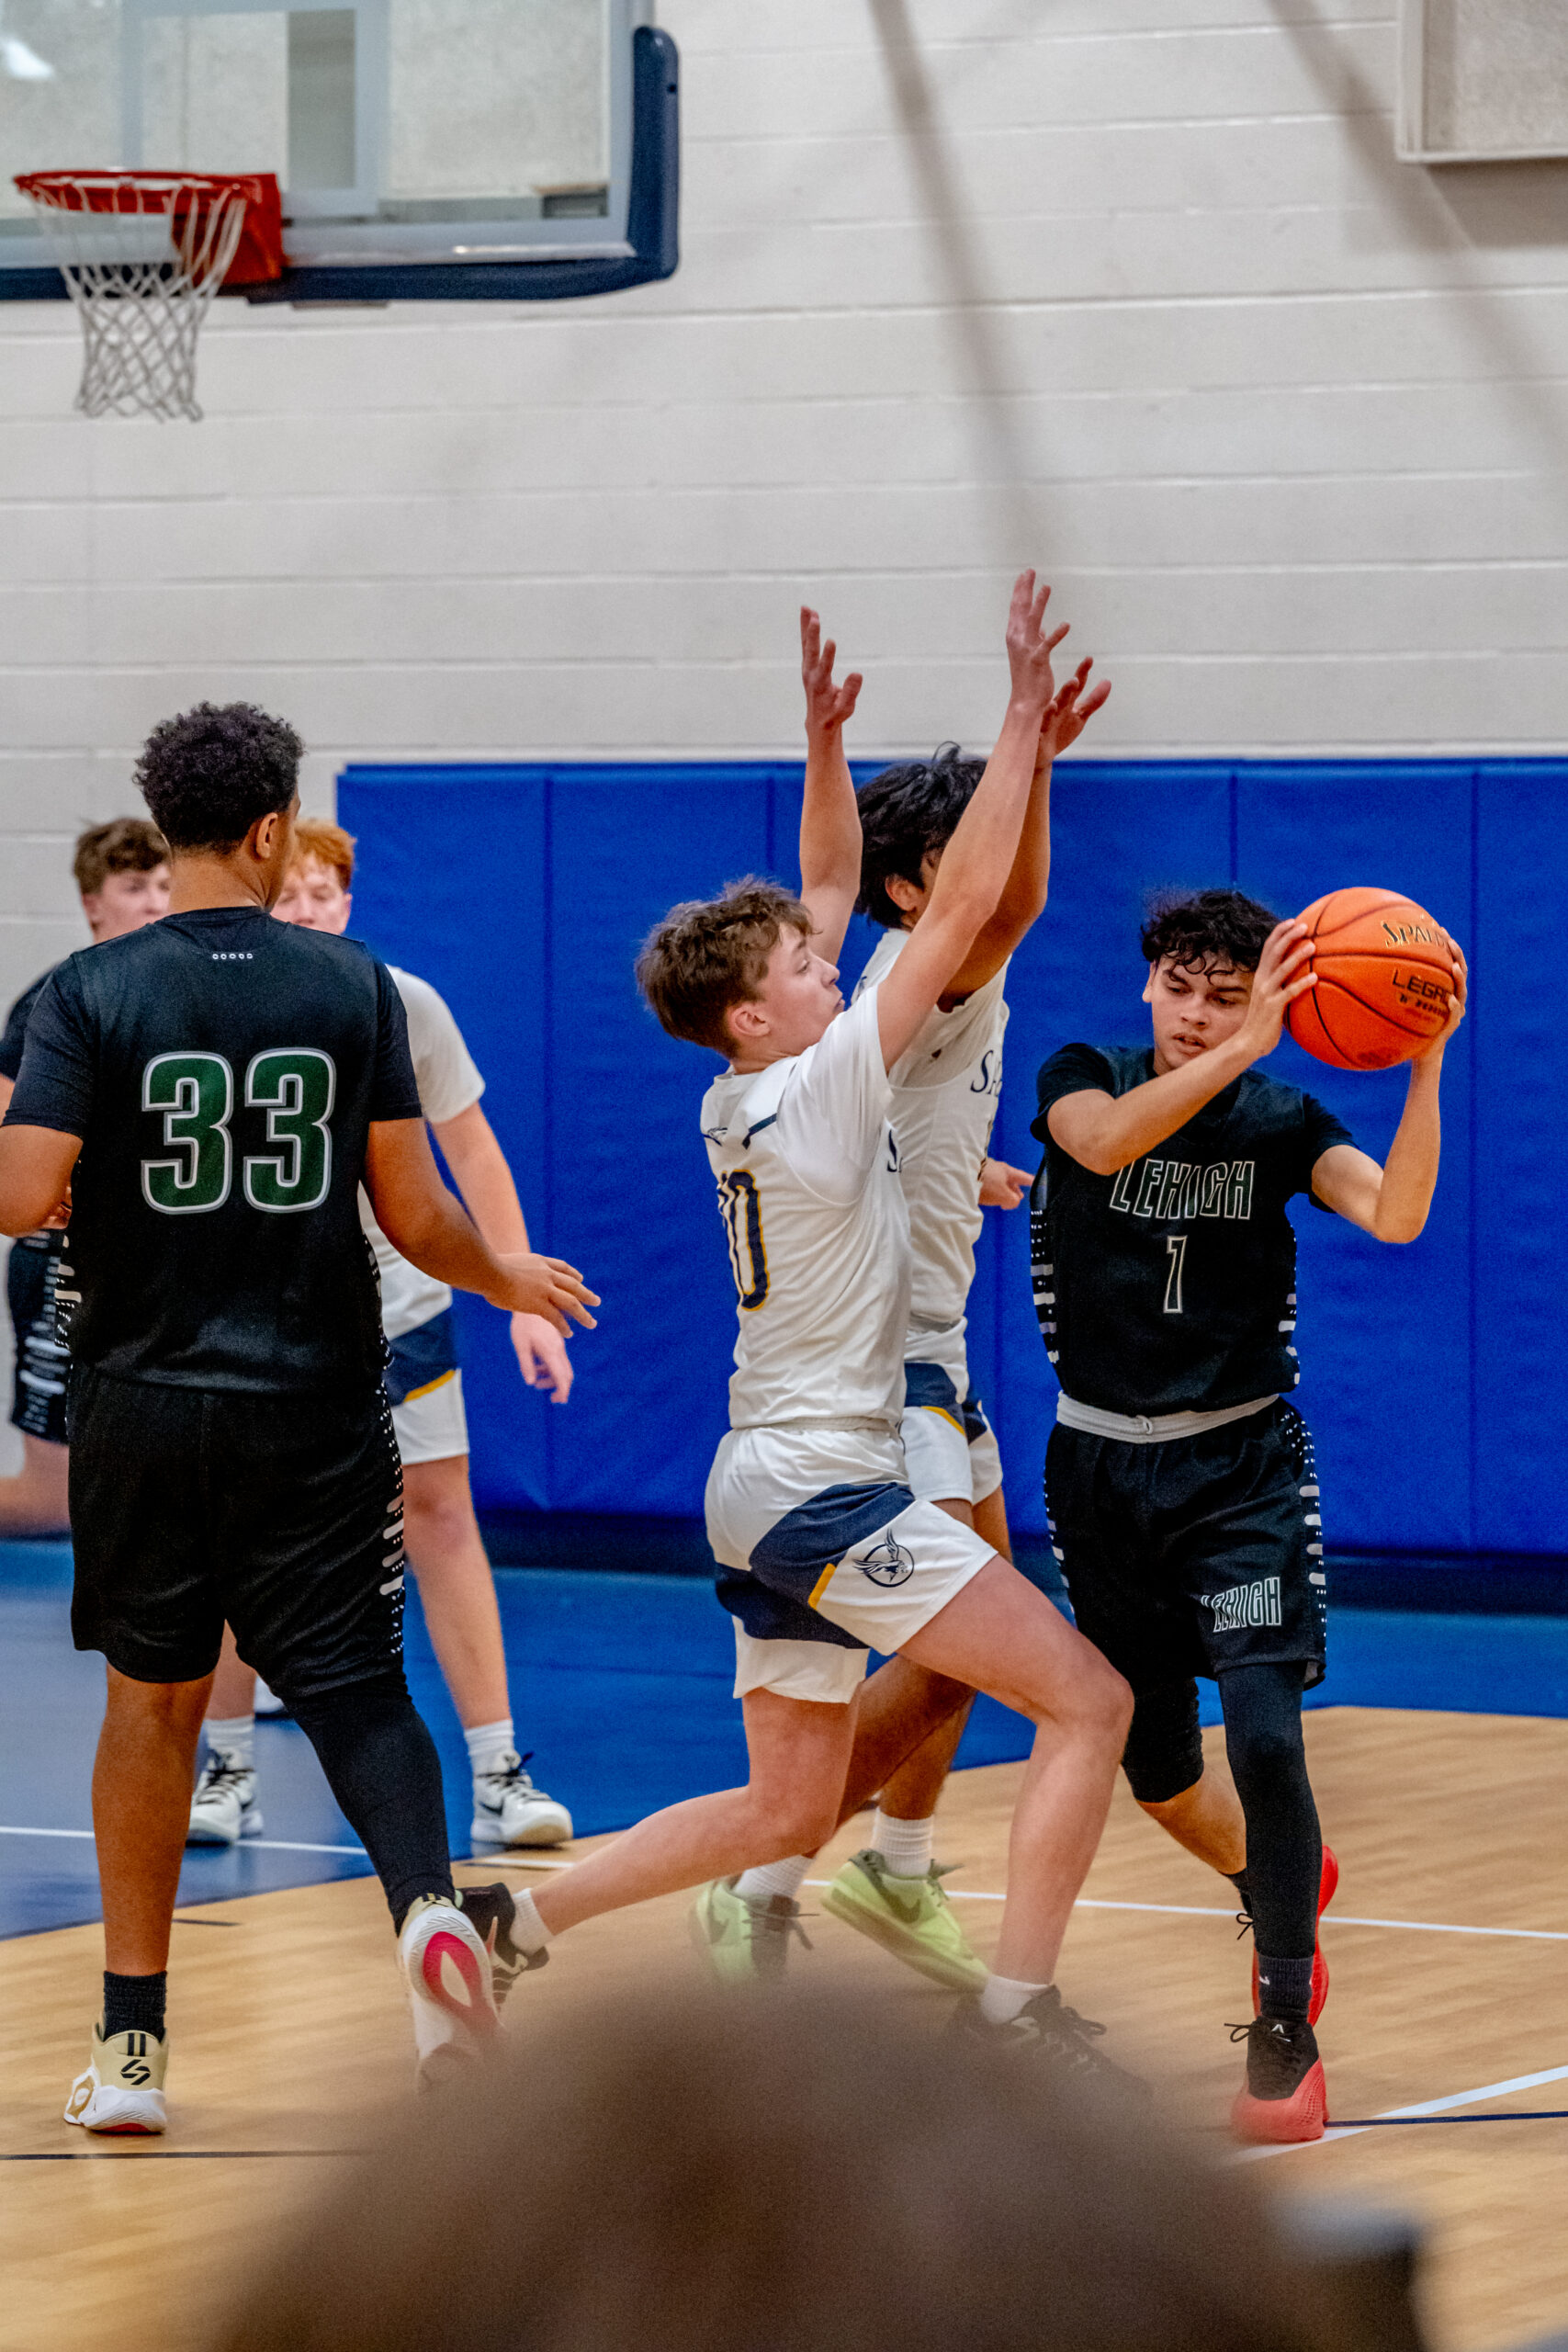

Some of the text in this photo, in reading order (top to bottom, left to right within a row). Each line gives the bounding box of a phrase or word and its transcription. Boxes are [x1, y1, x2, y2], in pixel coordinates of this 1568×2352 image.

[141, 1046, 336, 1215] 33
[1109, 1158, 1255, 1220] LEHIGH
[1201, 1577, 1282, 1633] LEHIGH
